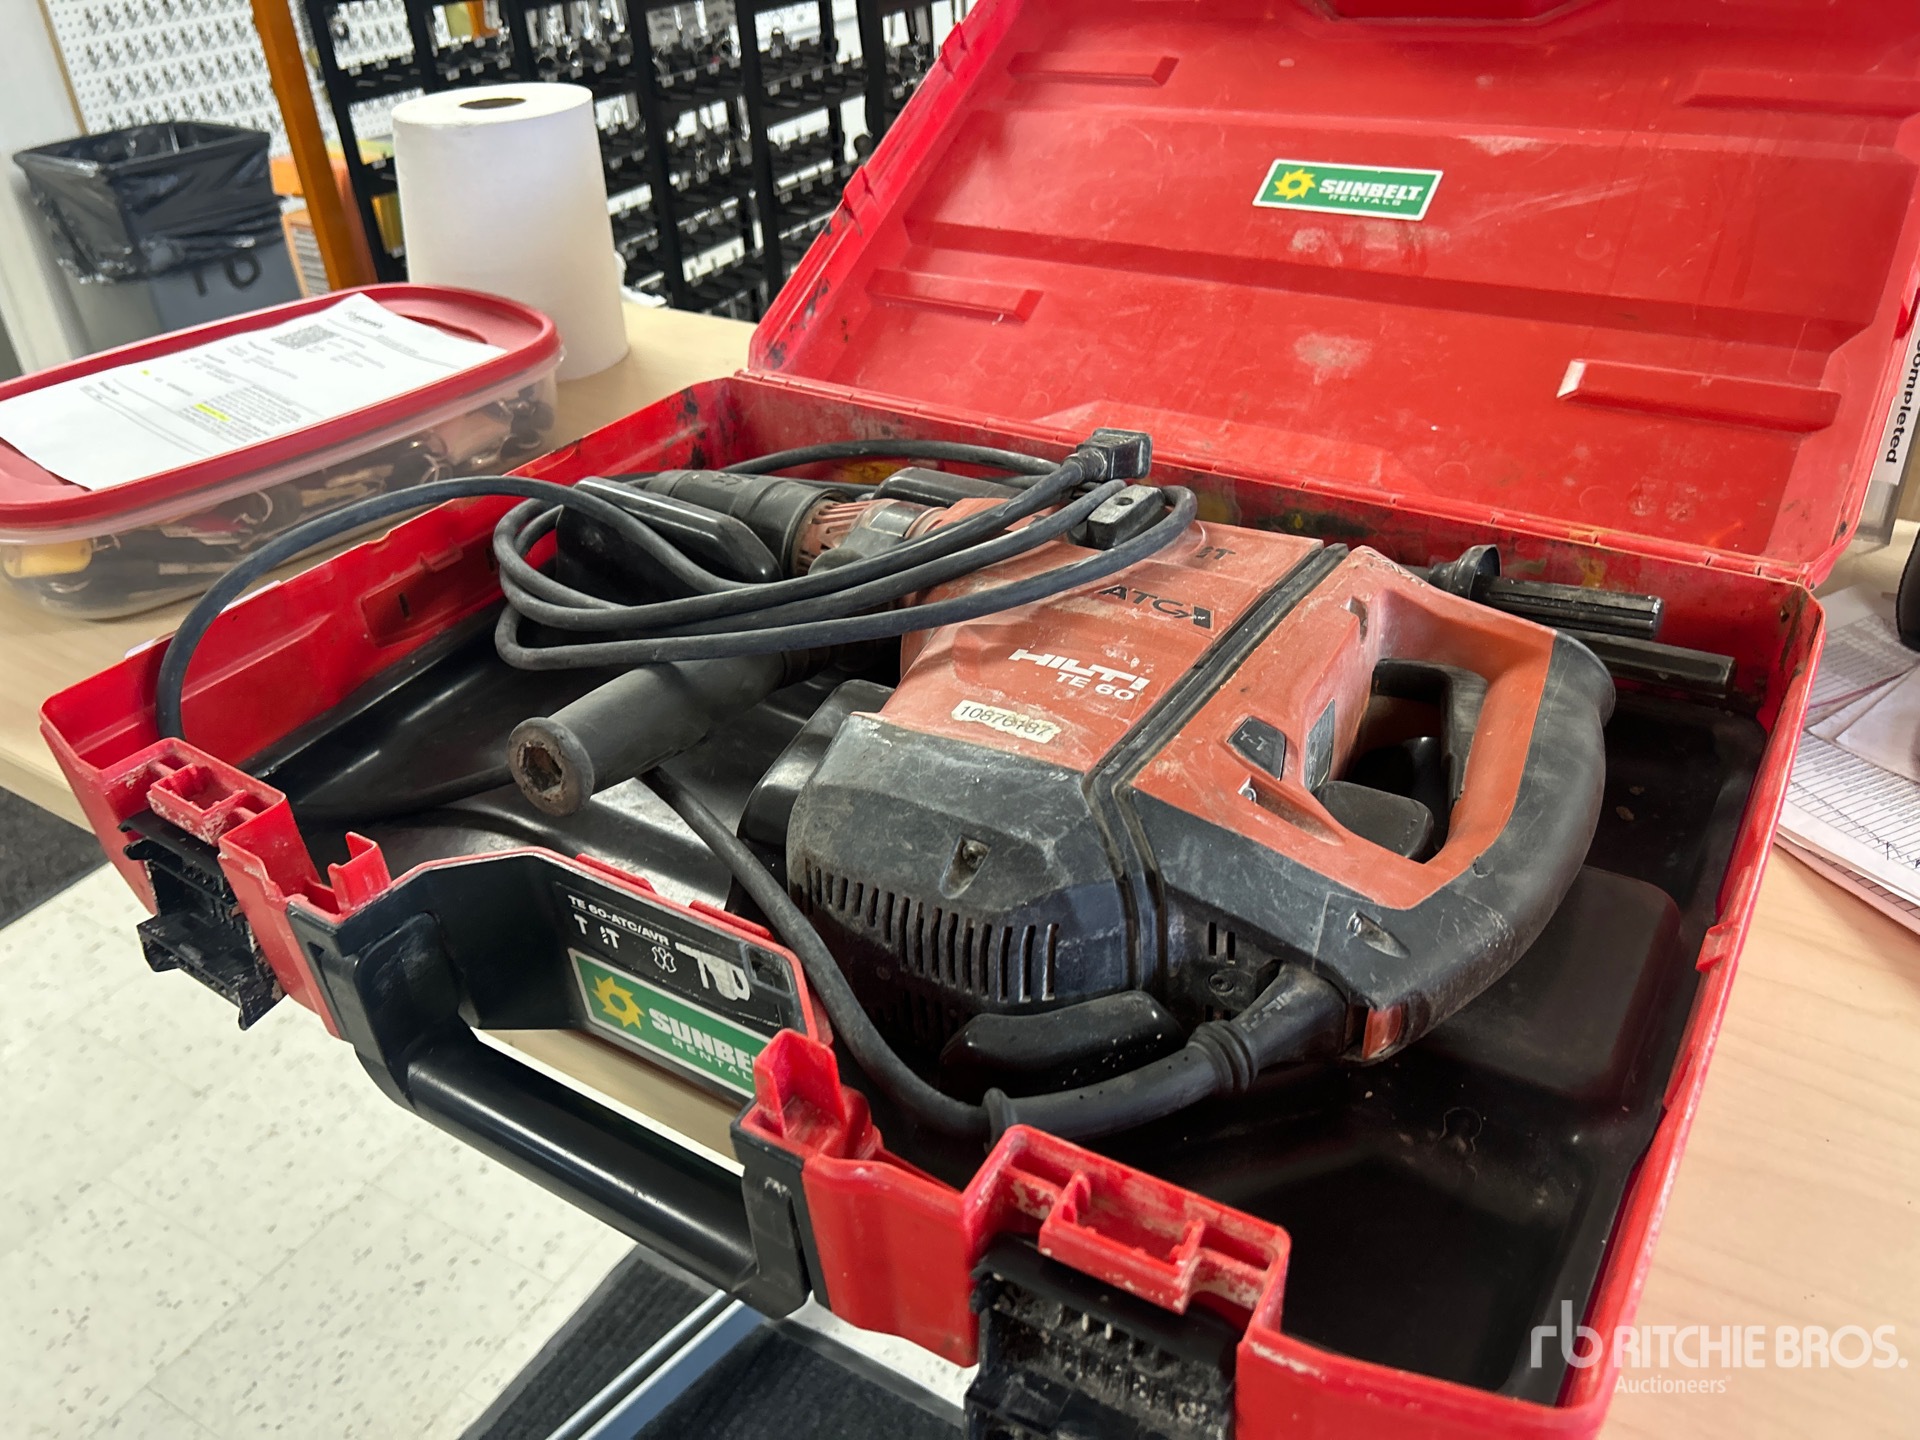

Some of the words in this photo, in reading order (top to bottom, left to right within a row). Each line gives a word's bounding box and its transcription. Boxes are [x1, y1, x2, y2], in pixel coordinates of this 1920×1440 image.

[1319, 179, 1424, 201] SUNBELT
[1328, 194, 1402, 206] RENTALS
[1886, 339, 1920, 464] ompleted
[1008, 648, 1151, 691] HILTI
[1056, 671, 1092, 688] TE
[1095, 683, 1135, 701] 60
[568, 894, 587, 910] TE
[588, 904, 670, 946] 60-ATC/AVR
[649, 1007, 757, 1075] SUNBE
[671, 1037, 753, 1083] RENTAL
